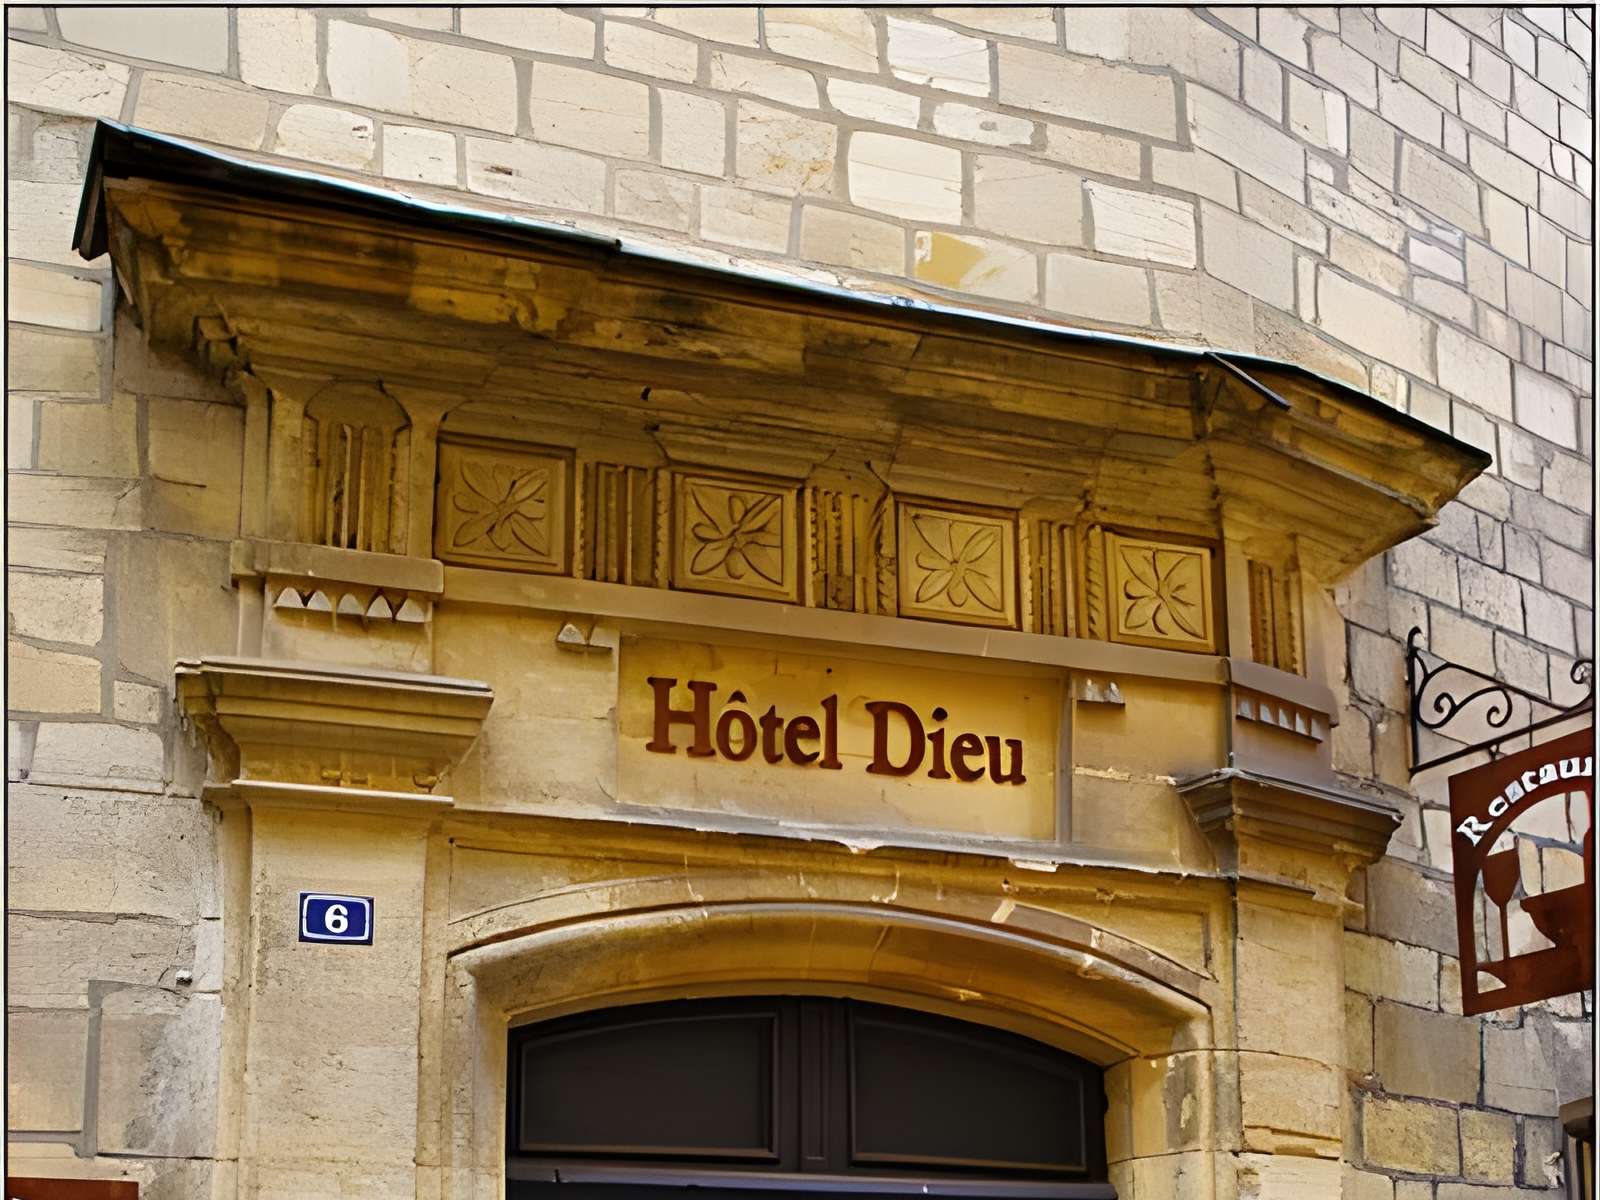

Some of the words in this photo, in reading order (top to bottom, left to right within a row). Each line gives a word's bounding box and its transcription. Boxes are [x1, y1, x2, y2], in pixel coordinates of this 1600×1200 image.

[646, 676, 843, 770] Hôtel
[865, 701, 1027, 786] Dieu
[325, 904, 348, 933] 6
